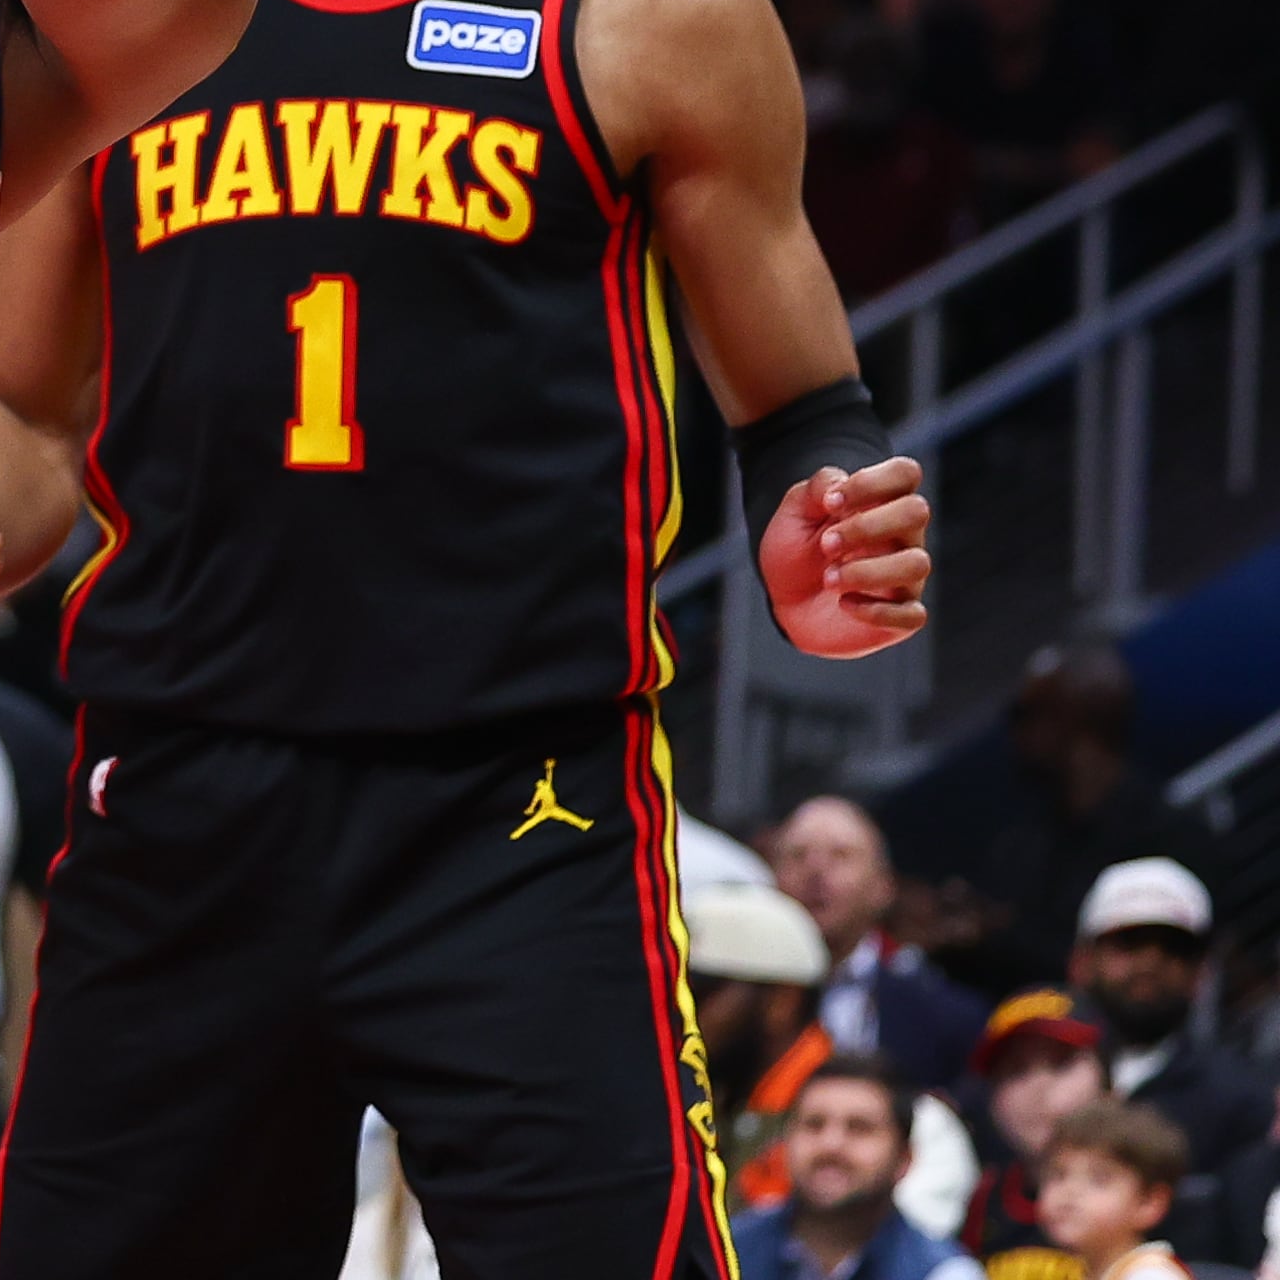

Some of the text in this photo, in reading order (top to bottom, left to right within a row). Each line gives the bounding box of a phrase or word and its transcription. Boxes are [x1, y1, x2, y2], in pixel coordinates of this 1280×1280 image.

[421, 18, 527, 55] paze
[130, 97, 541, 253] HAWKS
[283, 272, 365, 471] 1
